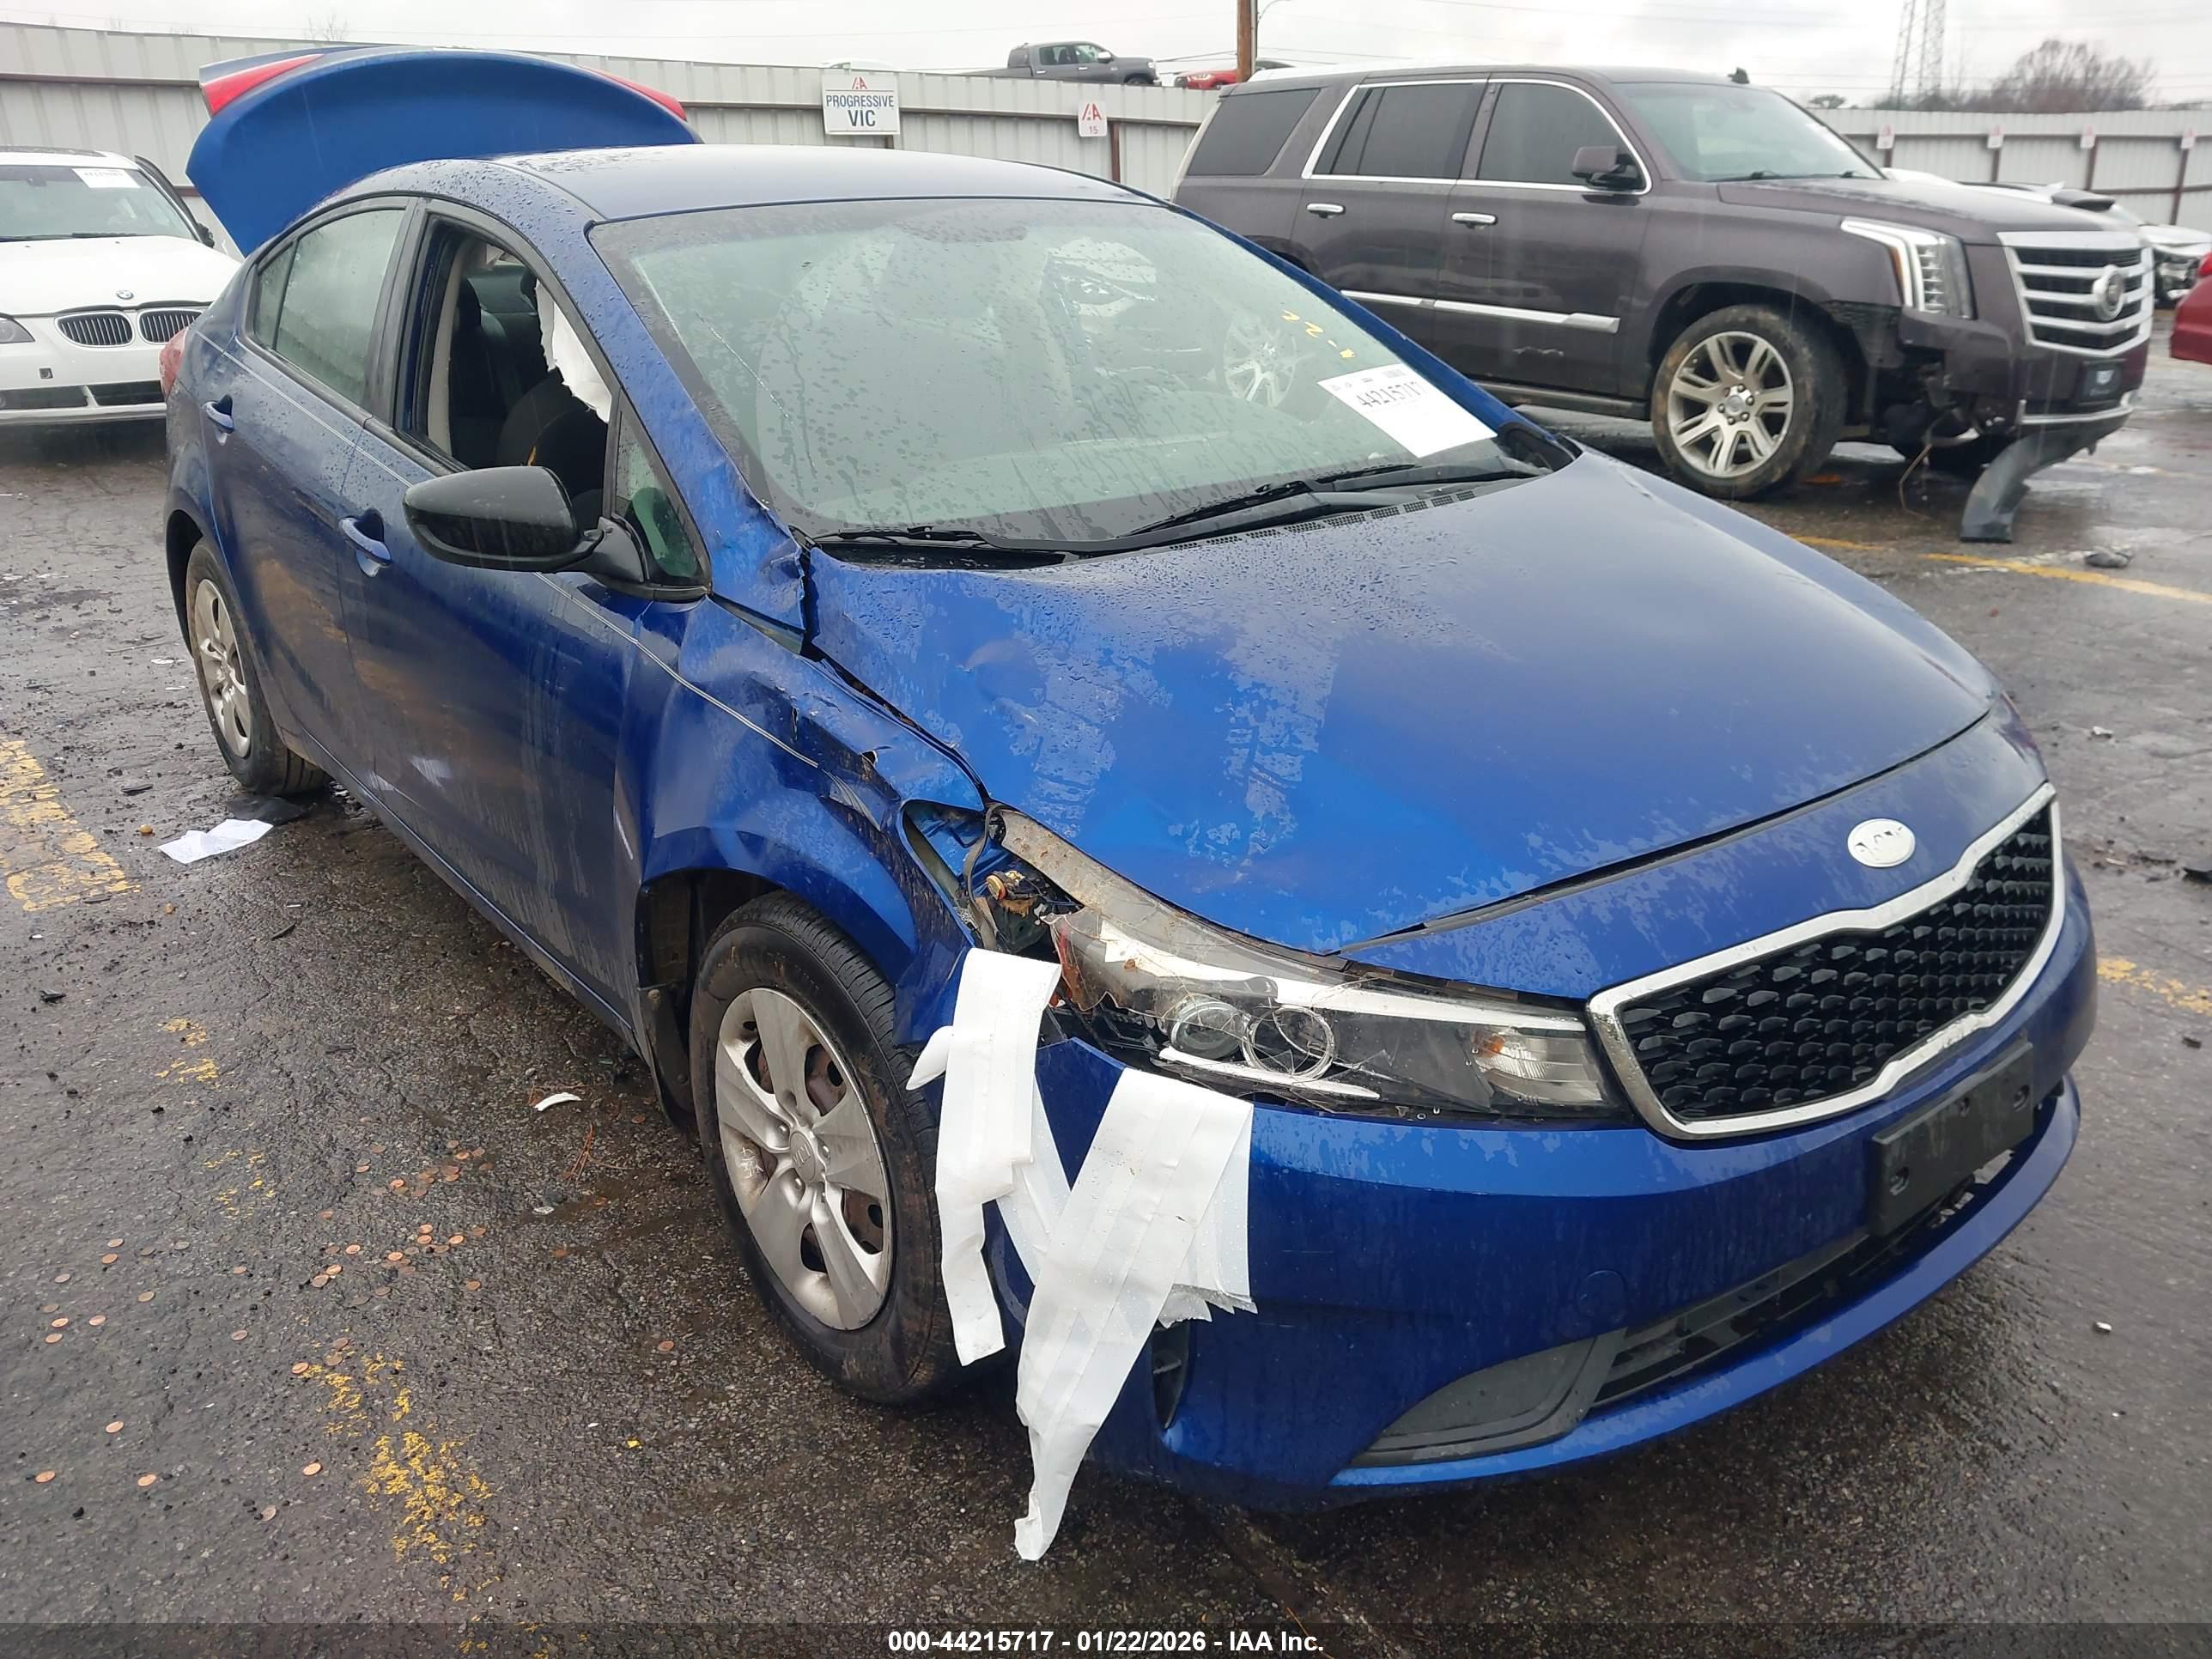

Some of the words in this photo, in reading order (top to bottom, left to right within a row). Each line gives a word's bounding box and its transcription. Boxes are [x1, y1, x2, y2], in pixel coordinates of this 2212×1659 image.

[826, 94, 894, 107] PROGRESSIVE
[848, 109, 877, 127] VIC
[1089, 125, 1098, 135] 15
